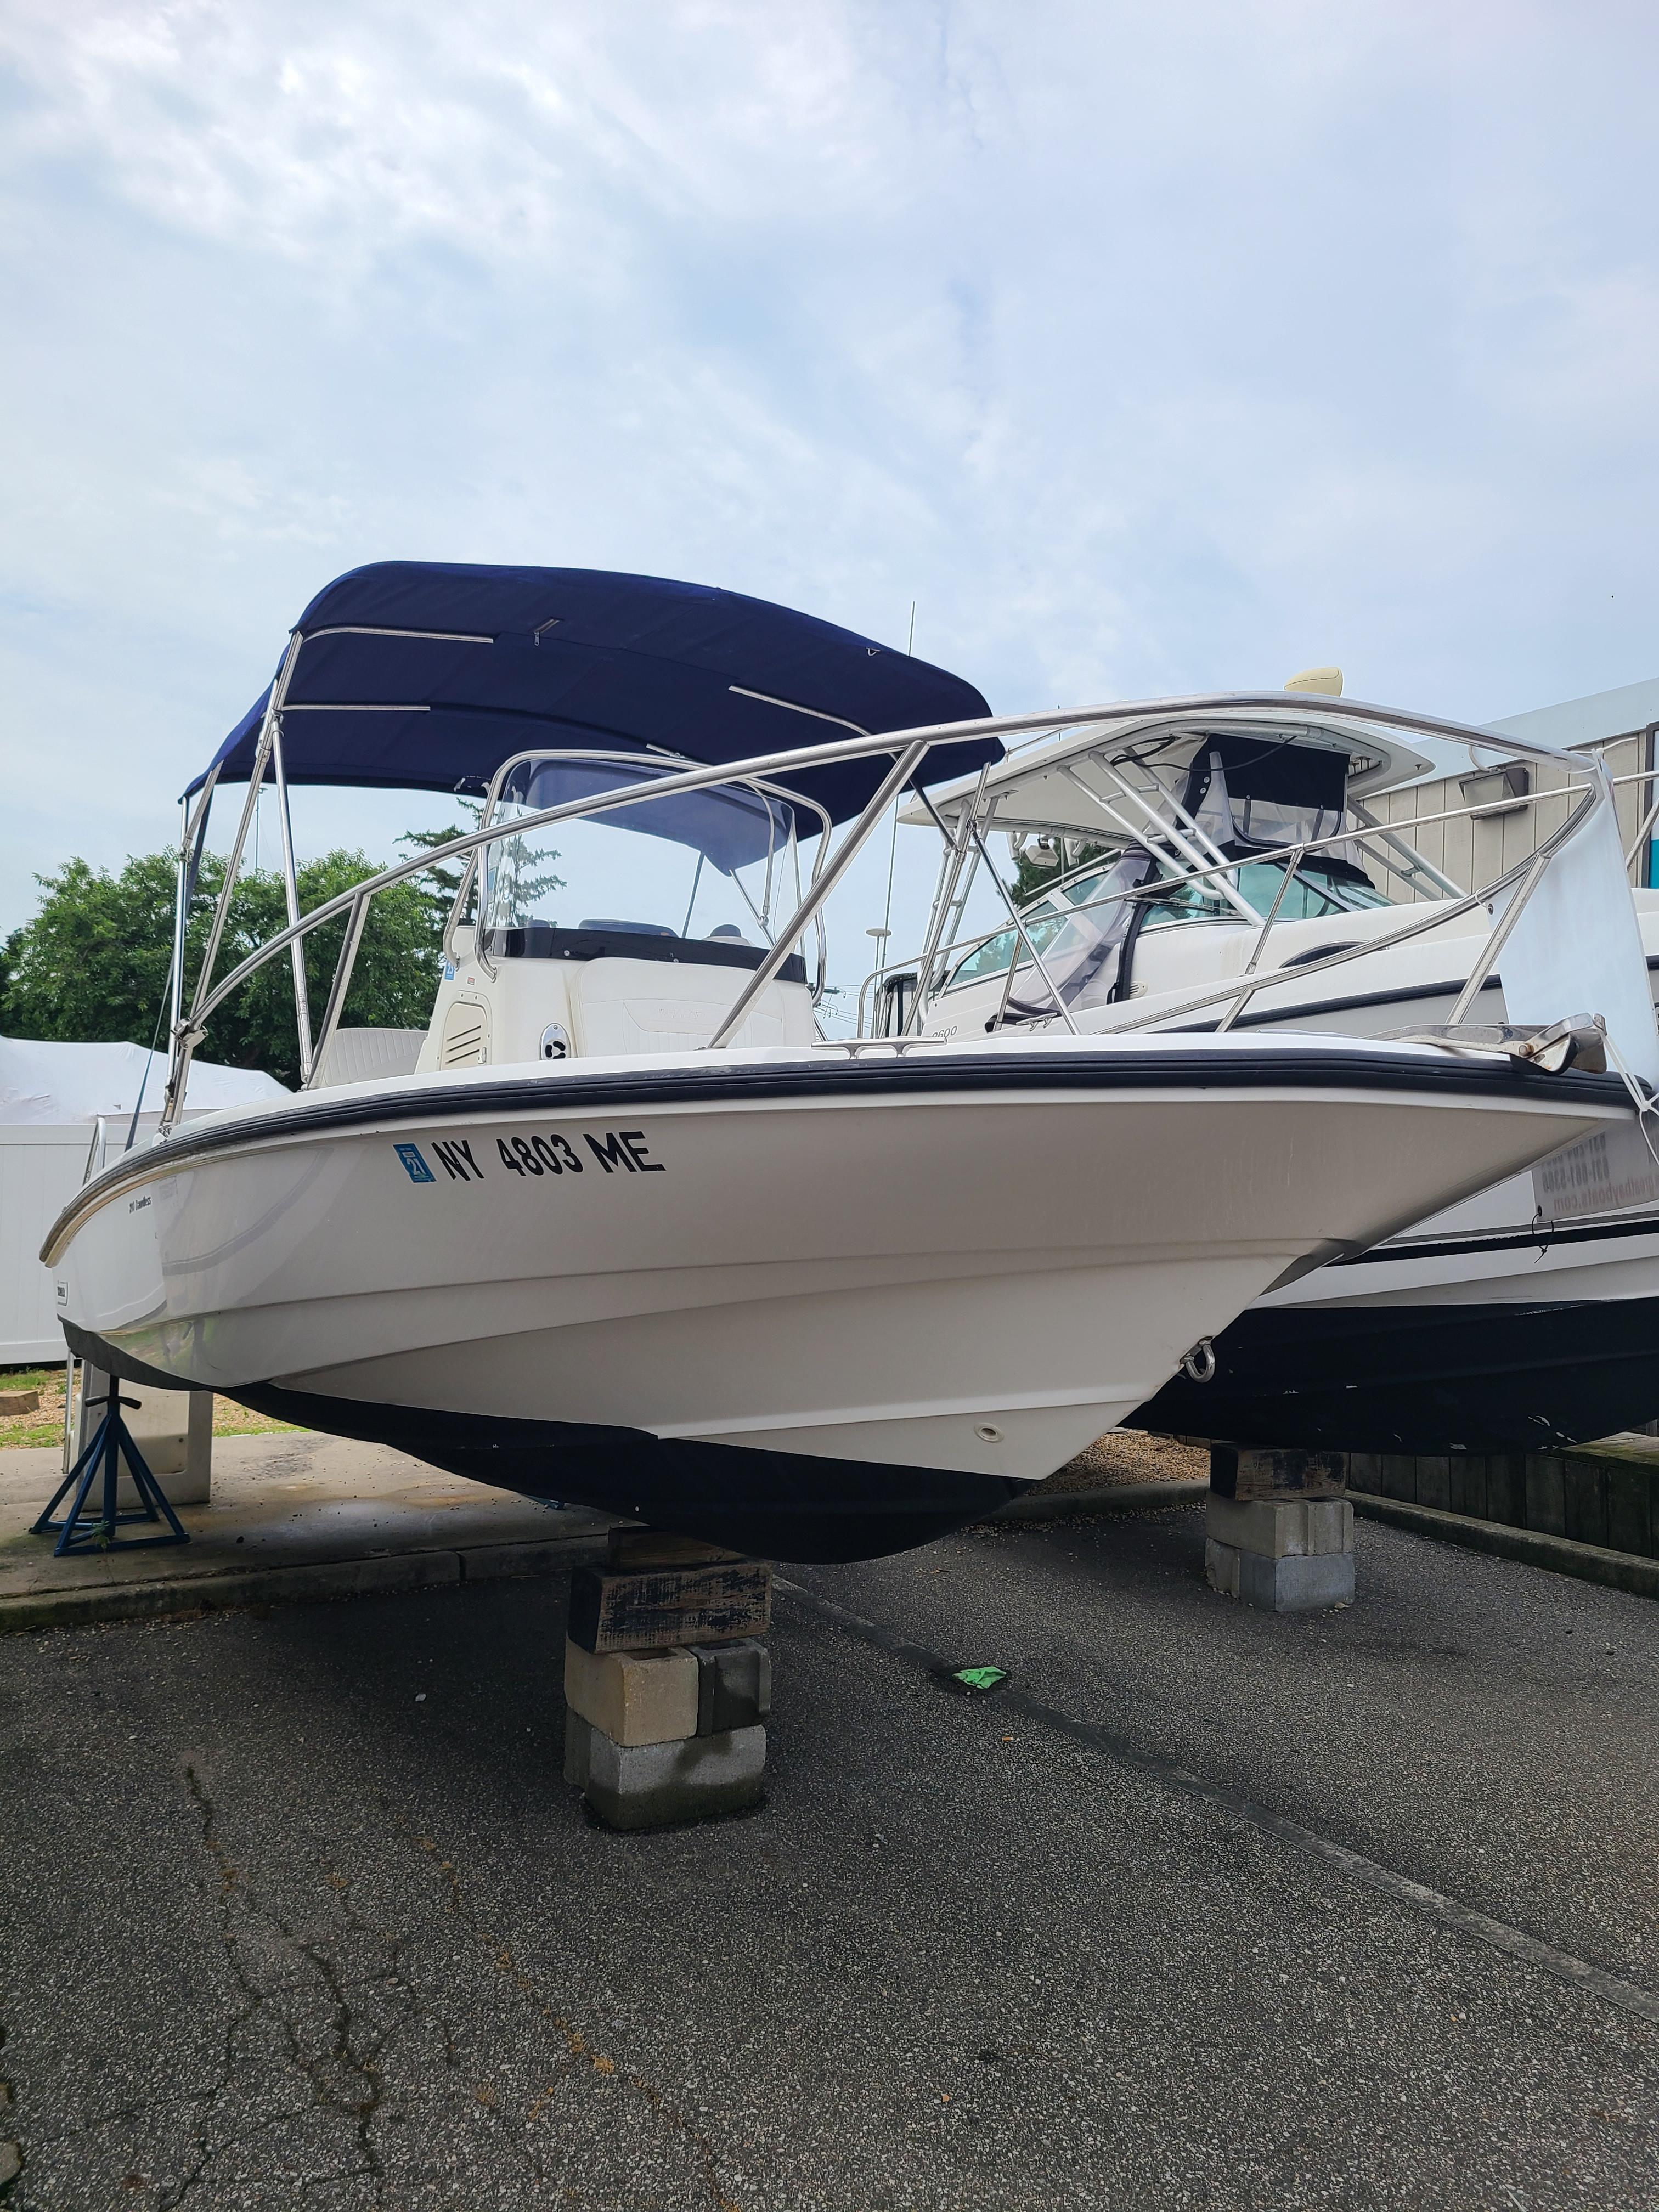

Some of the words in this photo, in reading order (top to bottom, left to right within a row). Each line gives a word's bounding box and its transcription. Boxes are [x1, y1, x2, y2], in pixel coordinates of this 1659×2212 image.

[407, 1158, 426, 1175] 21
[431, 1139, 485, 1181] NY
[496, 1133, 583, 1177] 4803
[583, 1131, 667, 1173] ME
